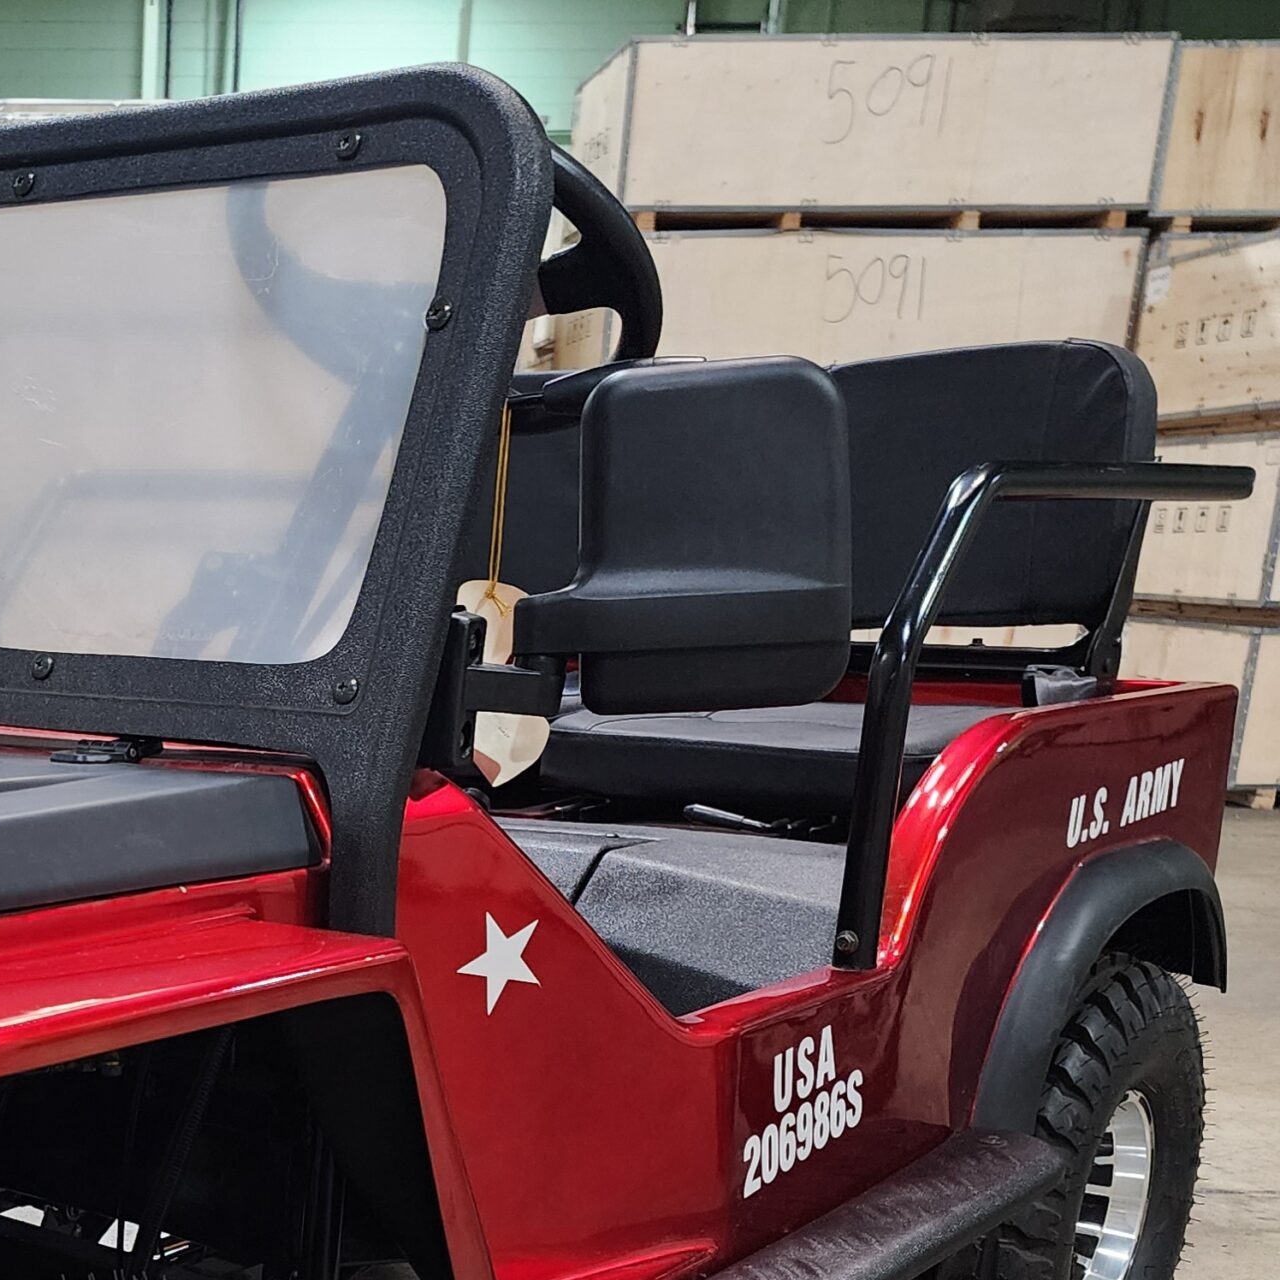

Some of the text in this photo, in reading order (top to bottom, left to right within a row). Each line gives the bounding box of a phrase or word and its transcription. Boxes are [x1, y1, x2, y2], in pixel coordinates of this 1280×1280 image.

[821, 54, 954, 144] 5091
[822, 254, 926, 324] 5091
[1066, 758, 1185, 848] U.S. ARMY
[773, 1025, 836, 1112] USA
[743, 1069, 864, 1199] 206986S
